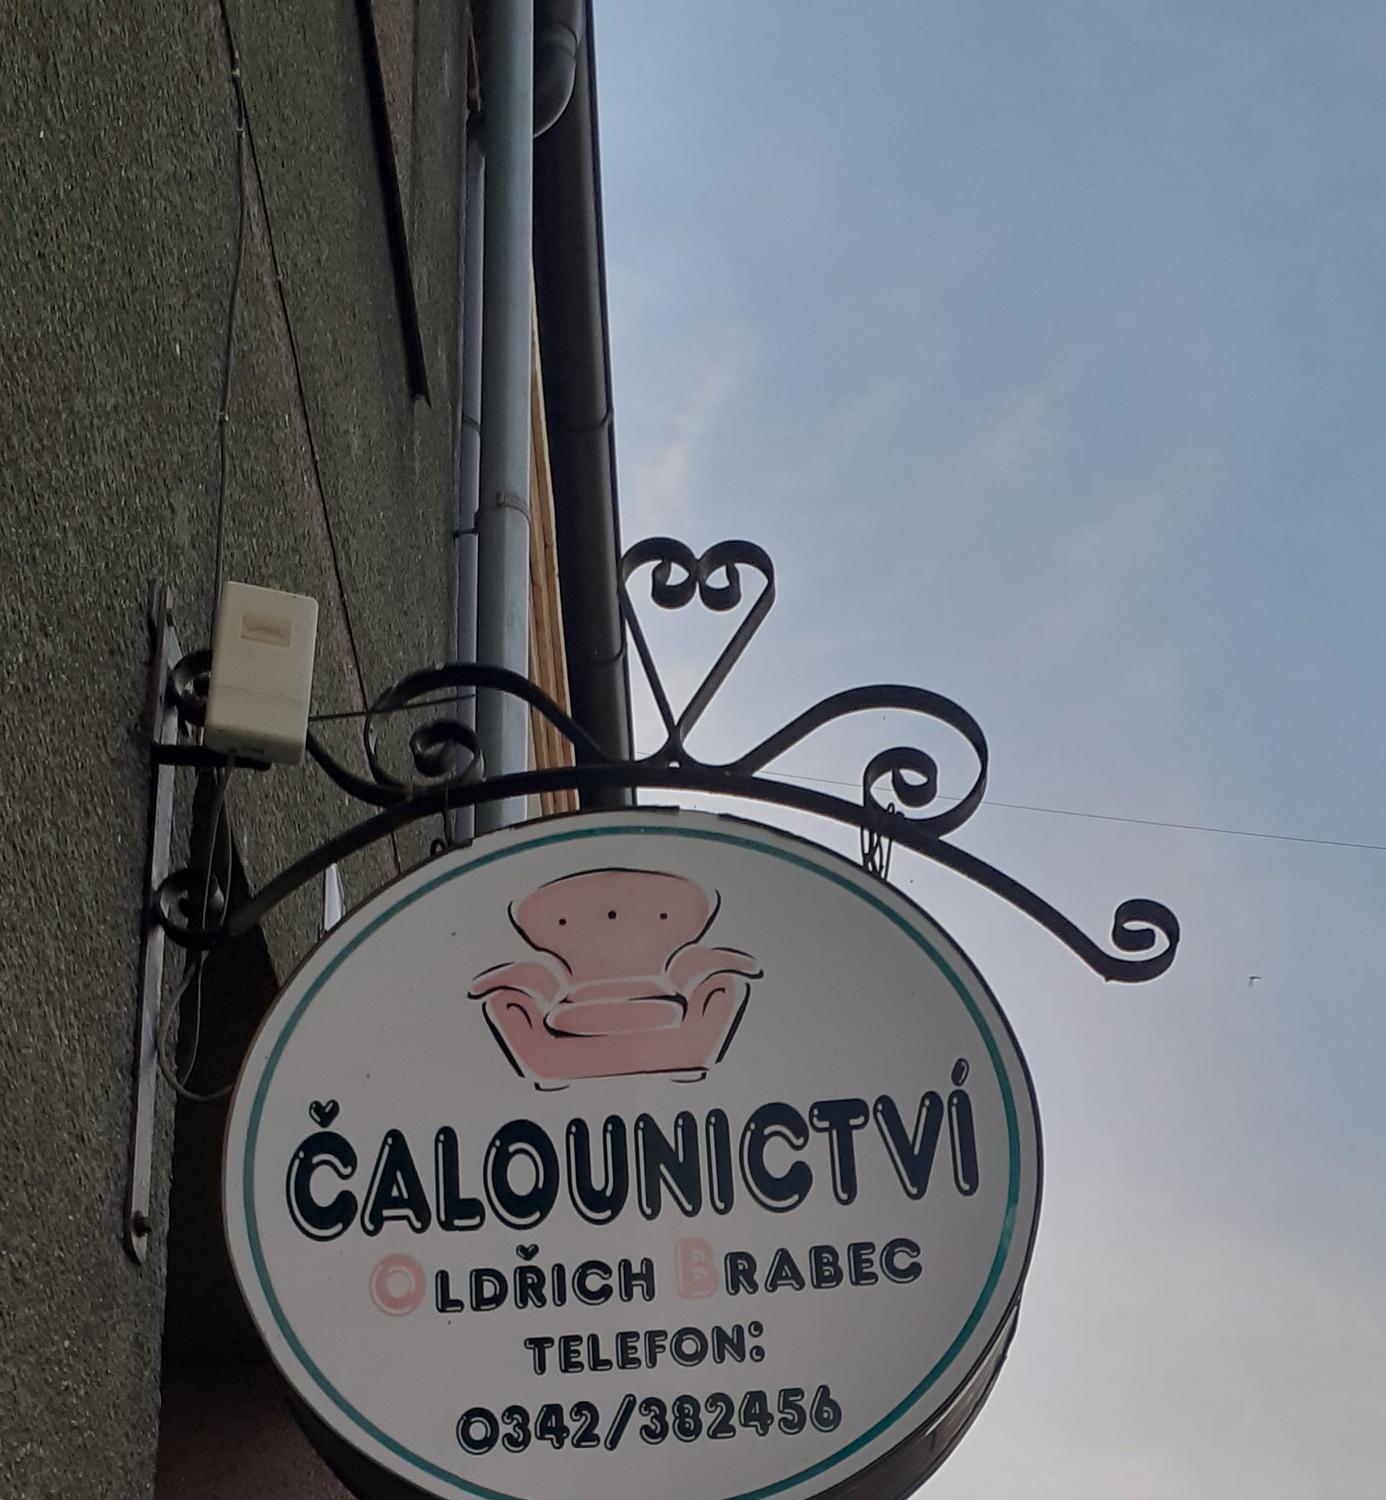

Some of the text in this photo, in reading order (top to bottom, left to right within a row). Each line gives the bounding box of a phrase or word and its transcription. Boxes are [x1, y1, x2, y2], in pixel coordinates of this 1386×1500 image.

[285, 1057, 979, 1242] ČALOUNICTVÍ
[369, 1238, 922, 1317] OLDŘICH BRABEC
[523, 1321, 765, 1375] TELEFON:
[456, 1385, 842, 1455] 0342/382456
